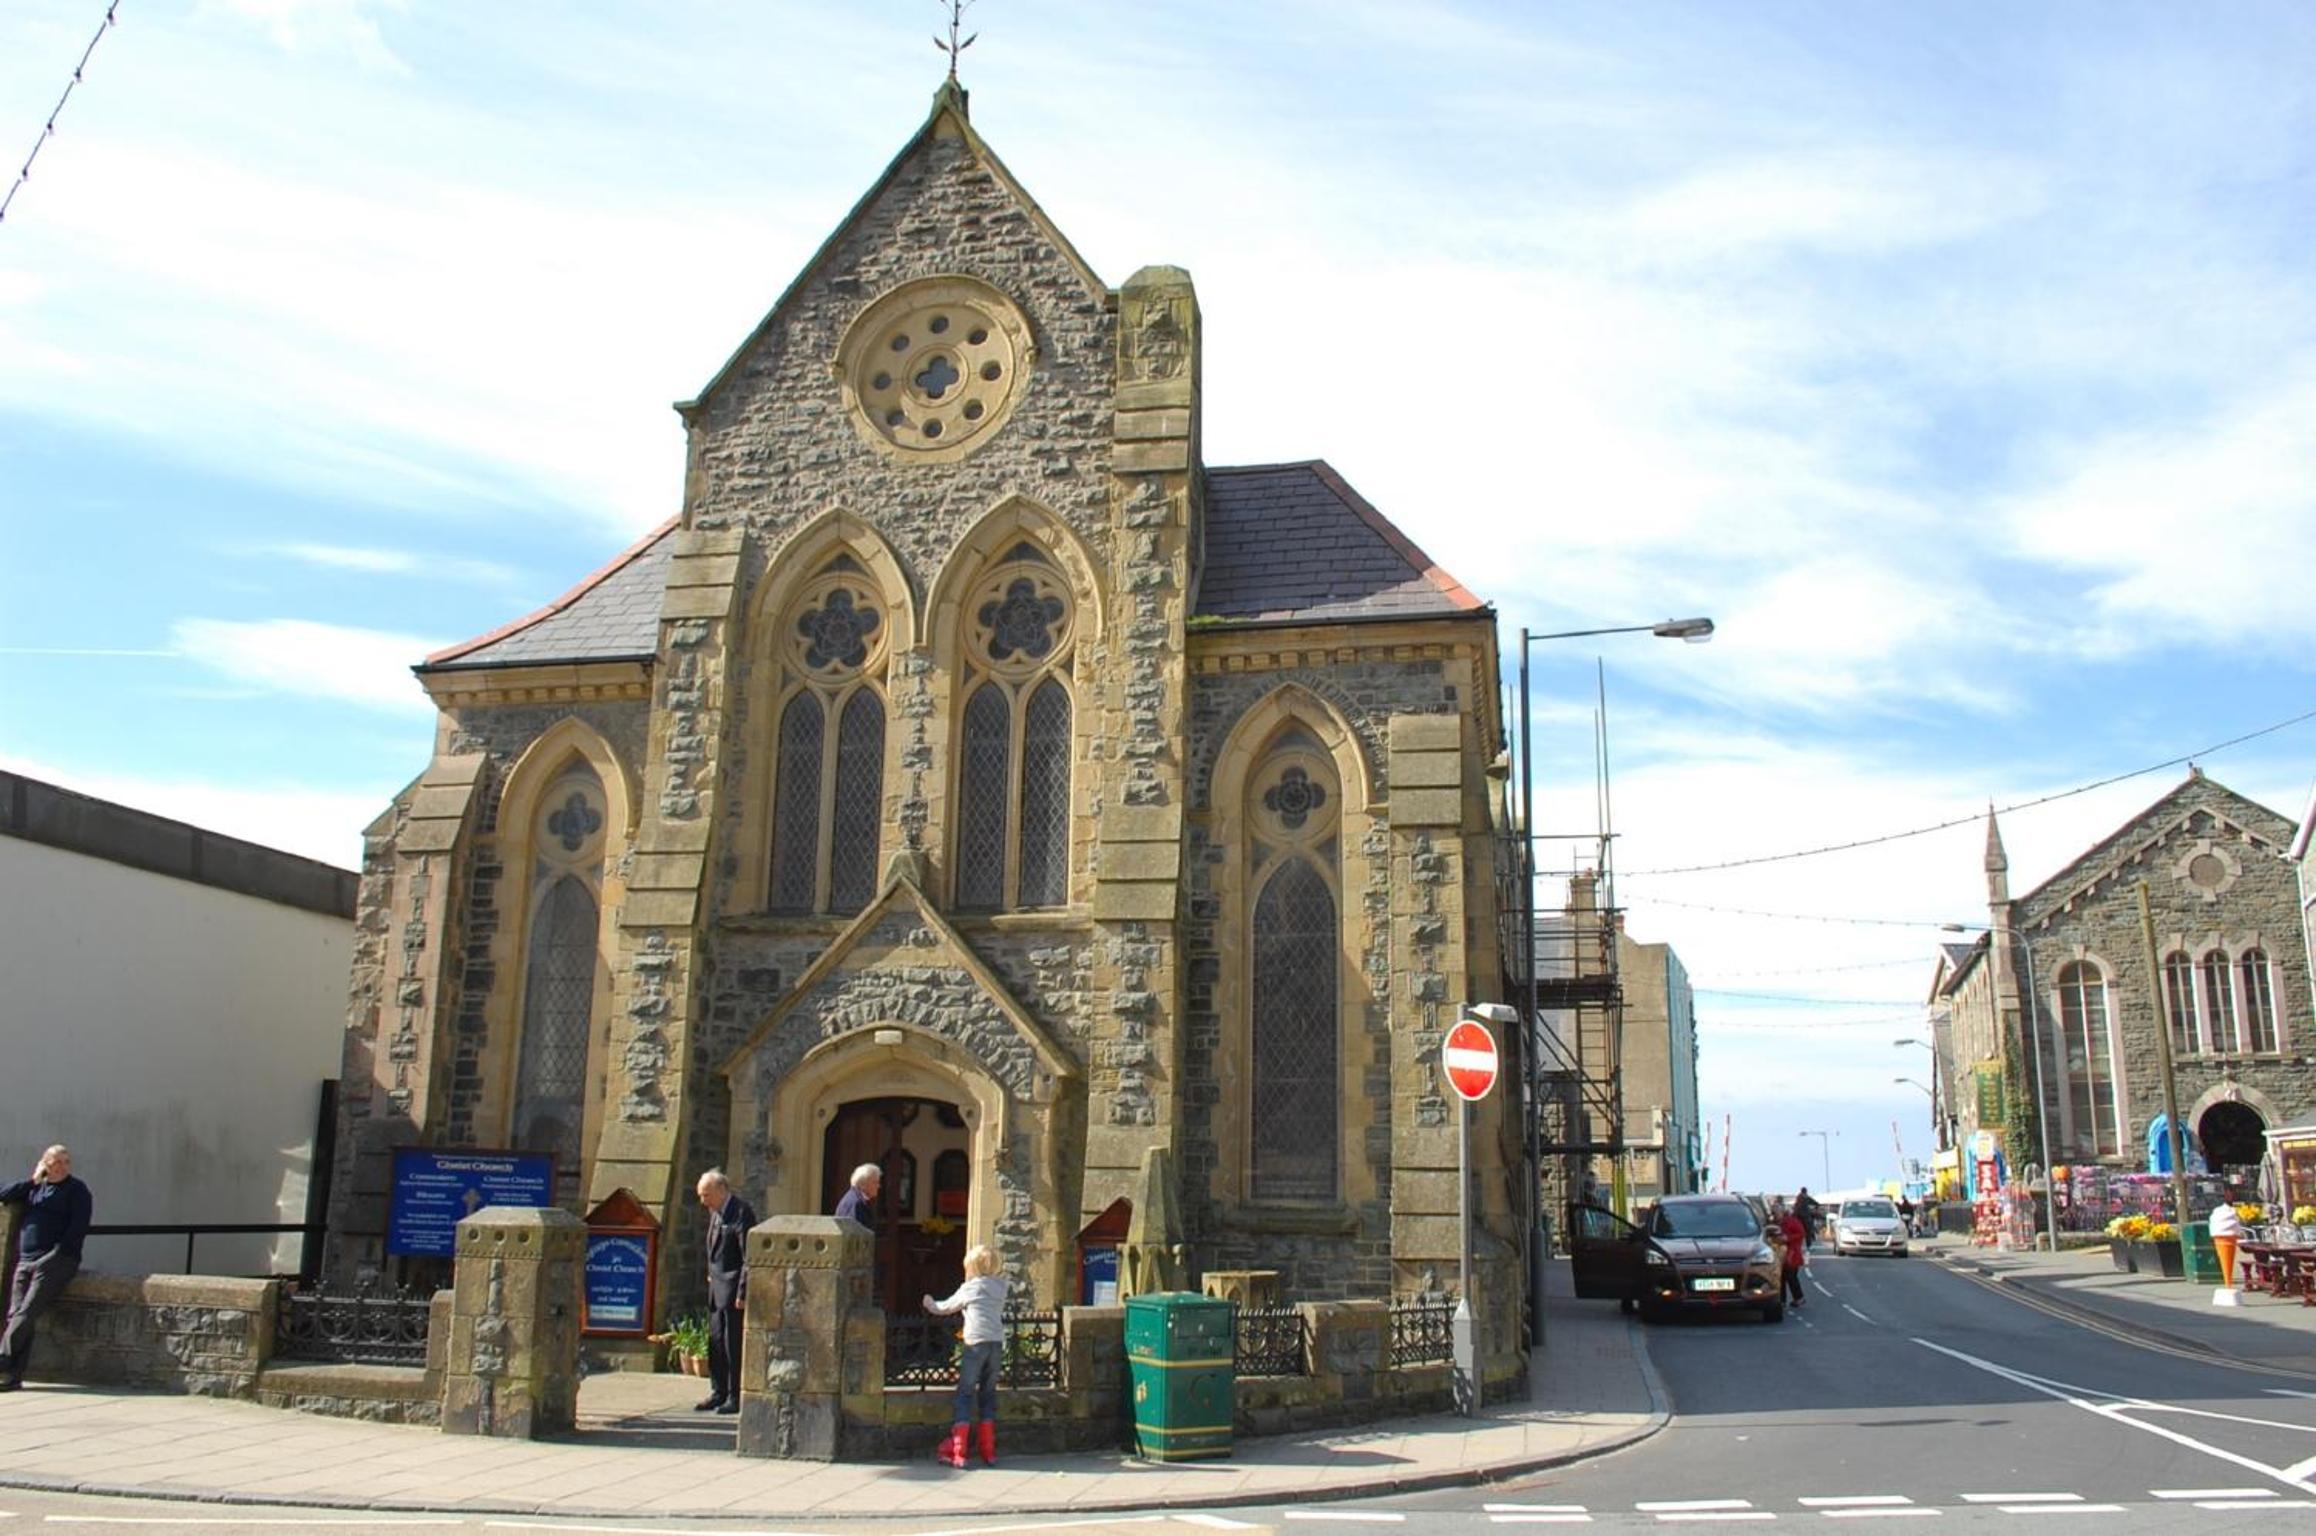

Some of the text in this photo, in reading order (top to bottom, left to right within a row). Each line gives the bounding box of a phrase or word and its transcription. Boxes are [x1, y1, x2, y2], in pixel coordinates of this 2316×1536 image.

[436, 1160, 514, 1173] Christ Church
[613, 1263, 646, 1273] Church
